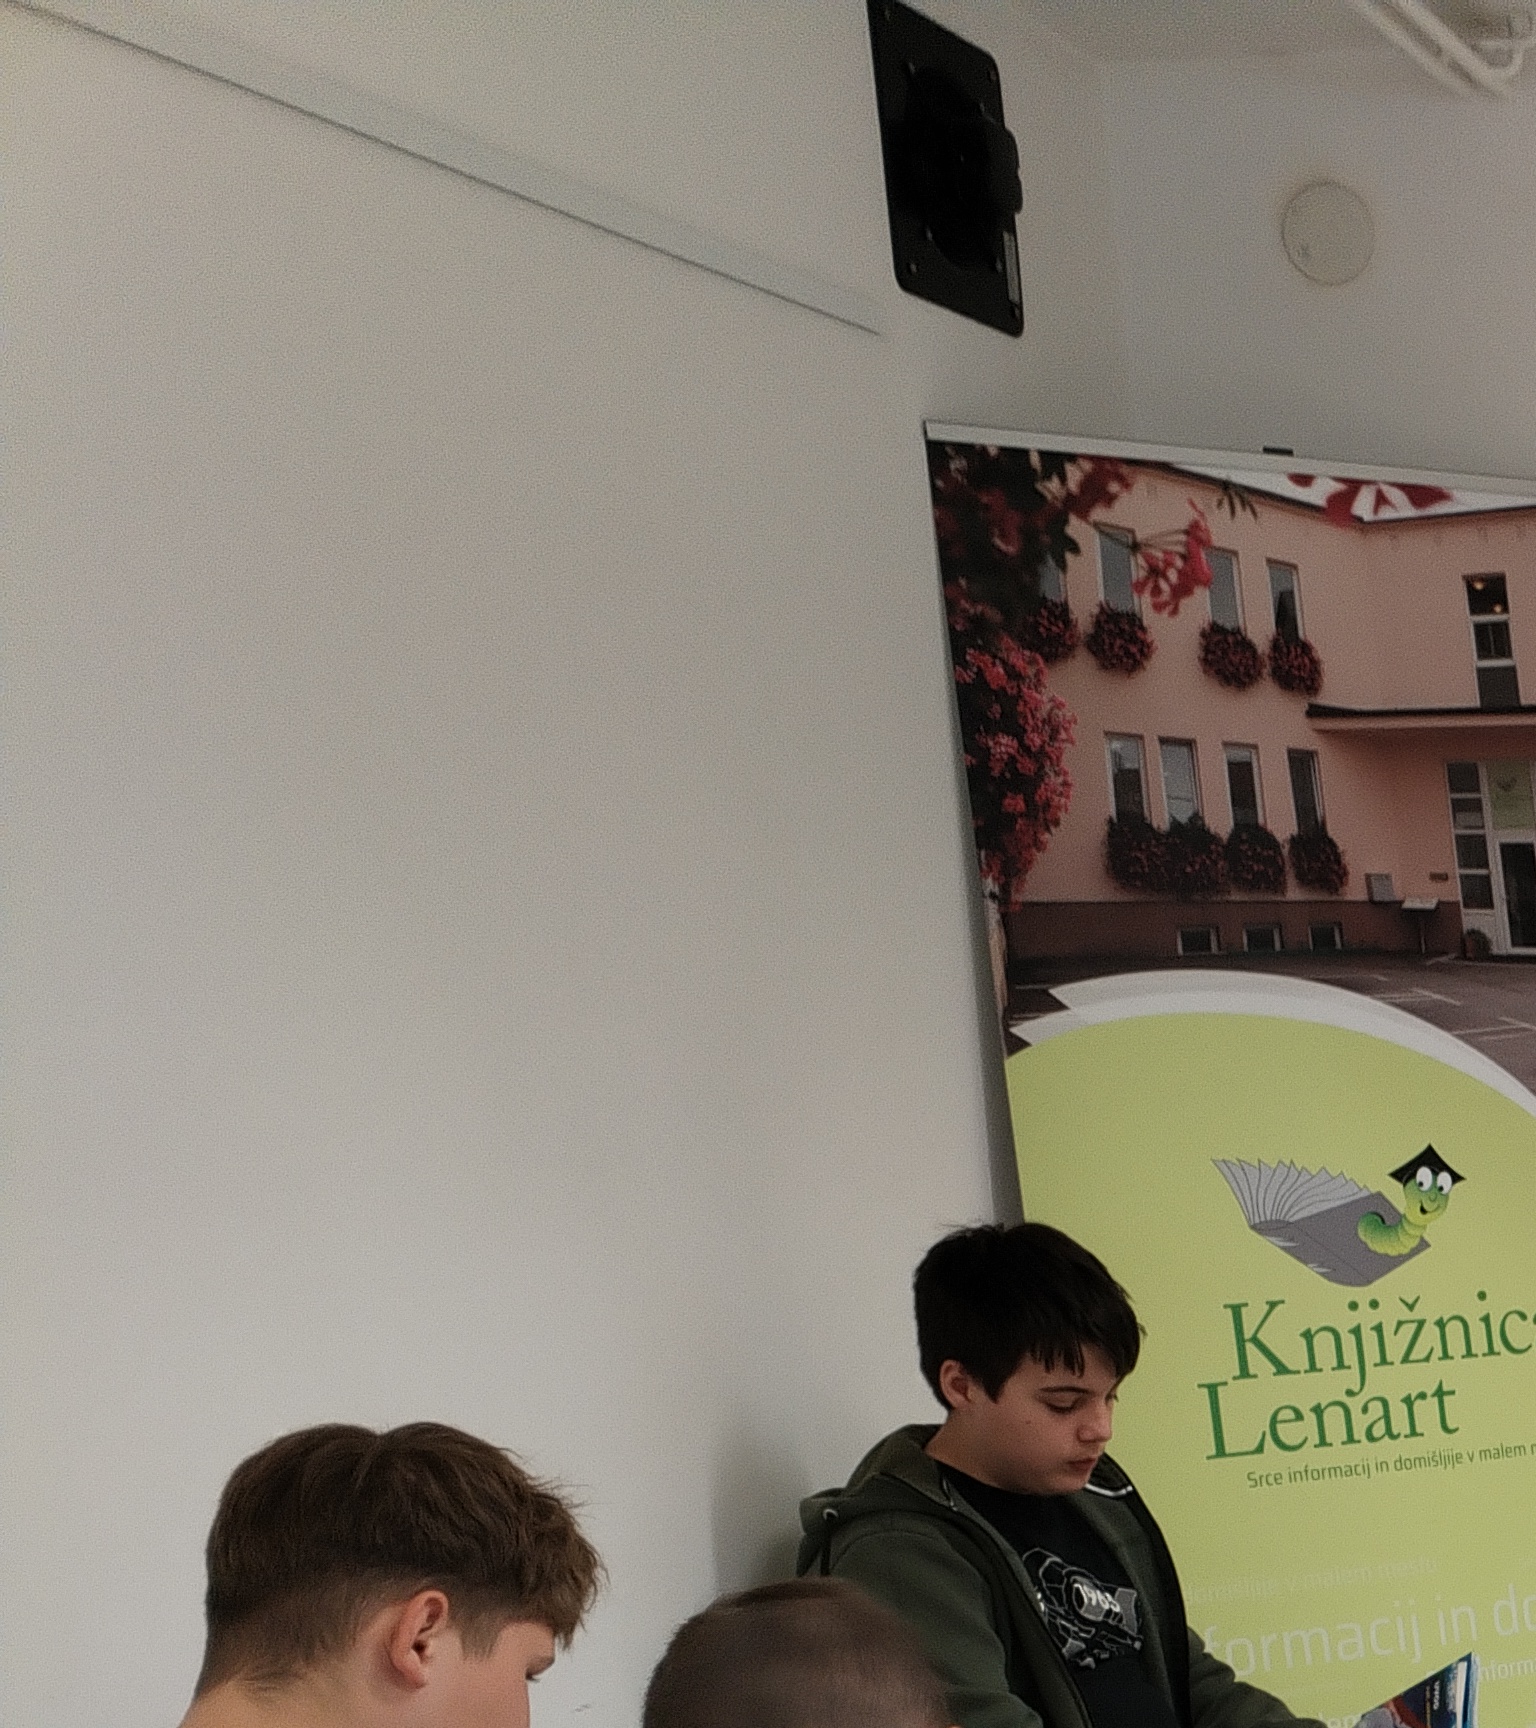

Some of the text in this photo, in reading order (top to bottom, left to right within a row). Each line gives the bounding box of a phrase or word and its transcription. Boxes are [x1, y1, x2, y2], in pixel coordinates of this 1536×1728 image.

[1197, 1379, 1460, 1460] Lenart
[1246, 1469, 1284, 1489] Srce
[1288, 1459, 1372, 1484] informacij
[1375, 1457, 1390, 1474] in
[1394, 1447, 1464, 1472] domišljije
[1466, 1450, 1476, 1464] v
[1478, 1442, 1528, 1463] malem
[1434, 1595, 1478, 1646] in
